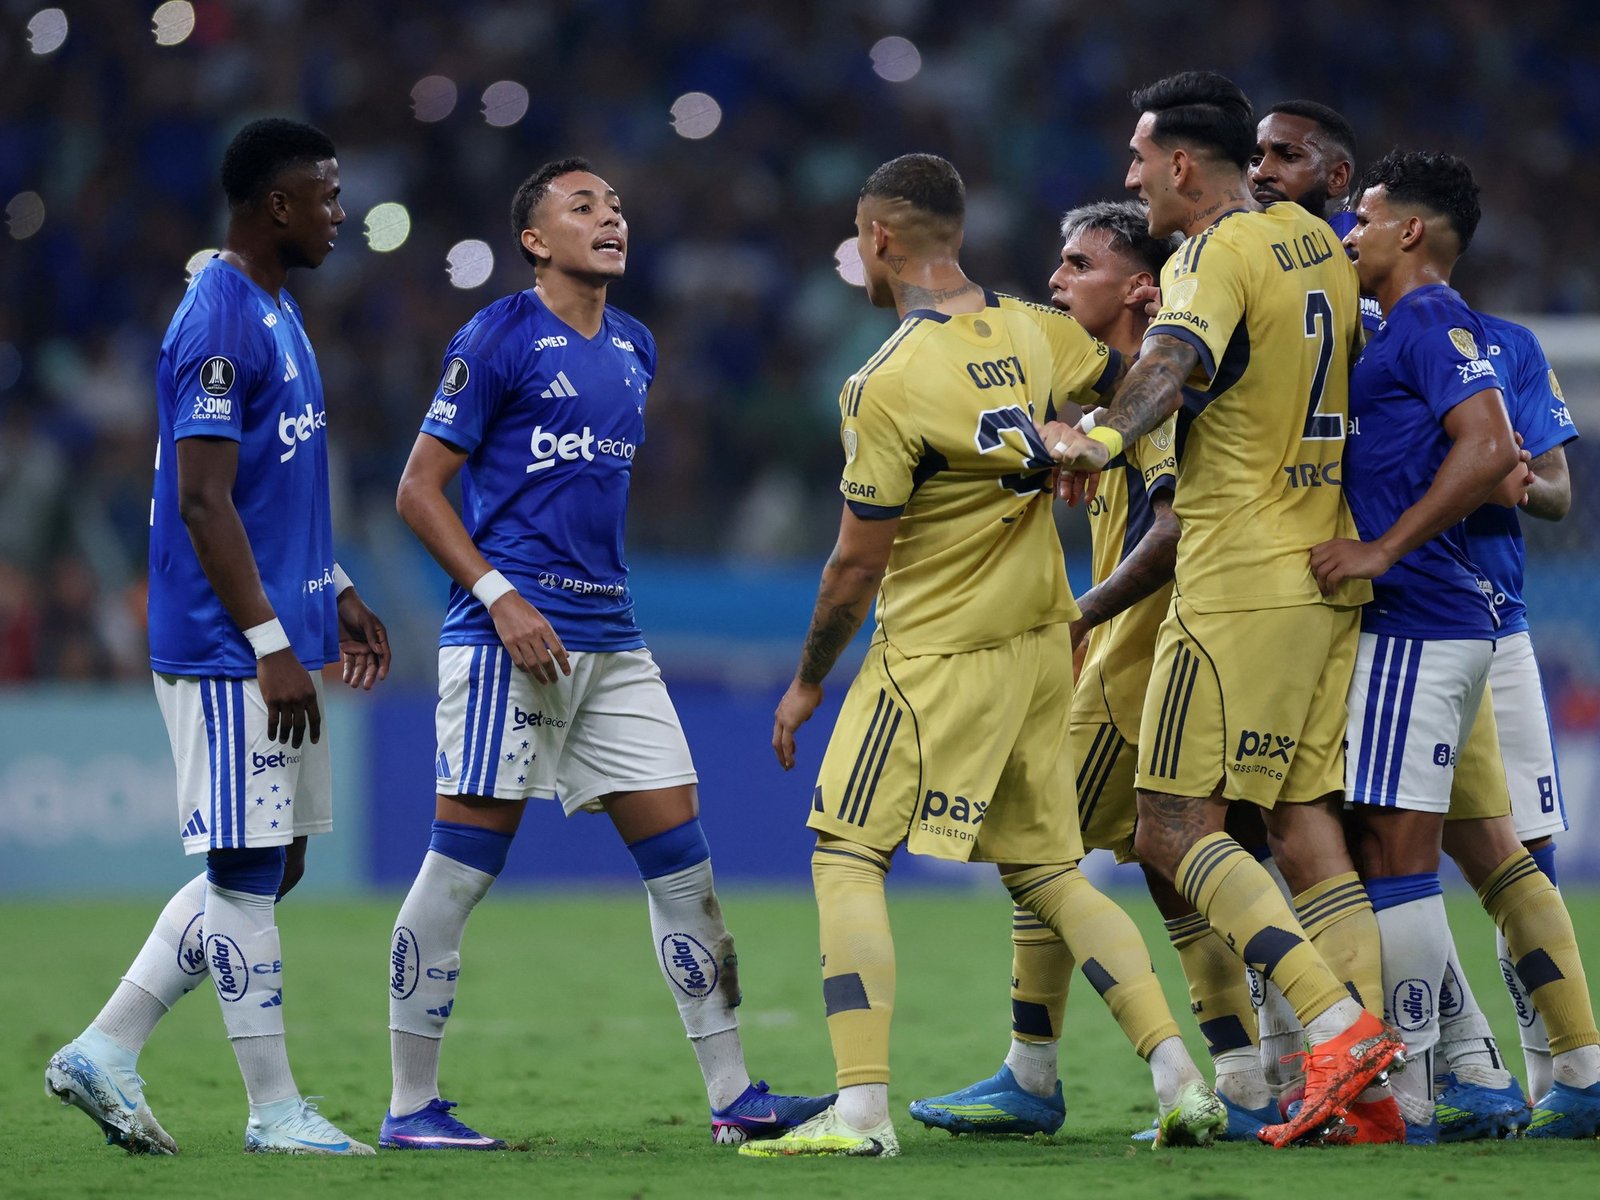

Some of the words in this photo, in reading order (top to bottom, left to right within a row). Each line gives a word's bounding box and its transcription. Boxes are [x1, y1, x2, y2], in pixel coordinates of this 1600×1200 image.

[1302, 289, 1345, 441] 2
[207, 397, 232, 415] OMO
[1235, 729, 1296, 765] pax
[921, 789, 991, 825] pax
[1537, 775, 1554, 814] 8
[214, 938, 239, 995] Kodilar
[391, 932, 410, 994] Kodilar
[672, 938, 708, 989] Kodilar
[1403, 983, 1424, 1024] dilar
